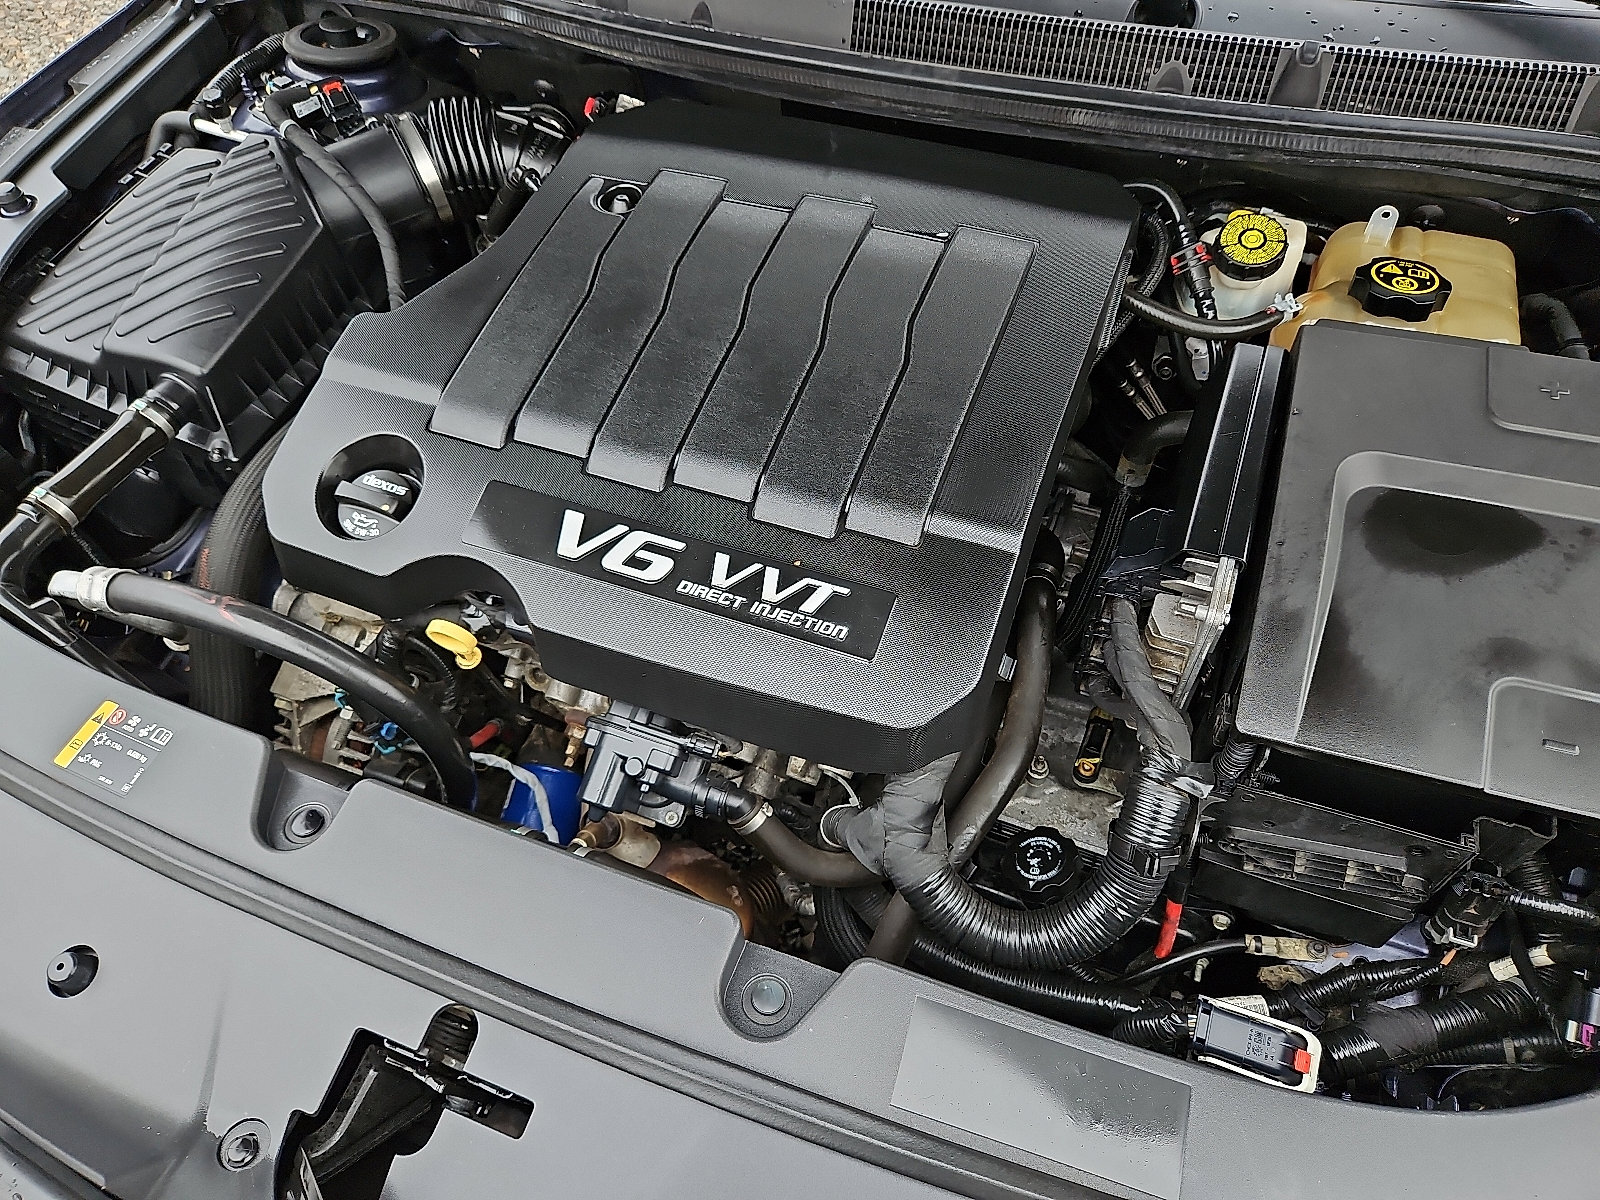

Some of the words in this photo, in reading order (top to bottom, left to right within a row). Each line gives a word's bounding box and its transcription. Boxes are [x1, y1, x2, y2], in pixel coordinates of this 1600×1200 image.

[362, 474, 410, 496] dexos
[354, 527, 380, 537] 5W-30
[556, 507, 688, 585] V6
[710, 551, 852, 616] VVT
[675, 578, 747, 609] DIRECT
[749, 602, 850, 641] INJECTION
